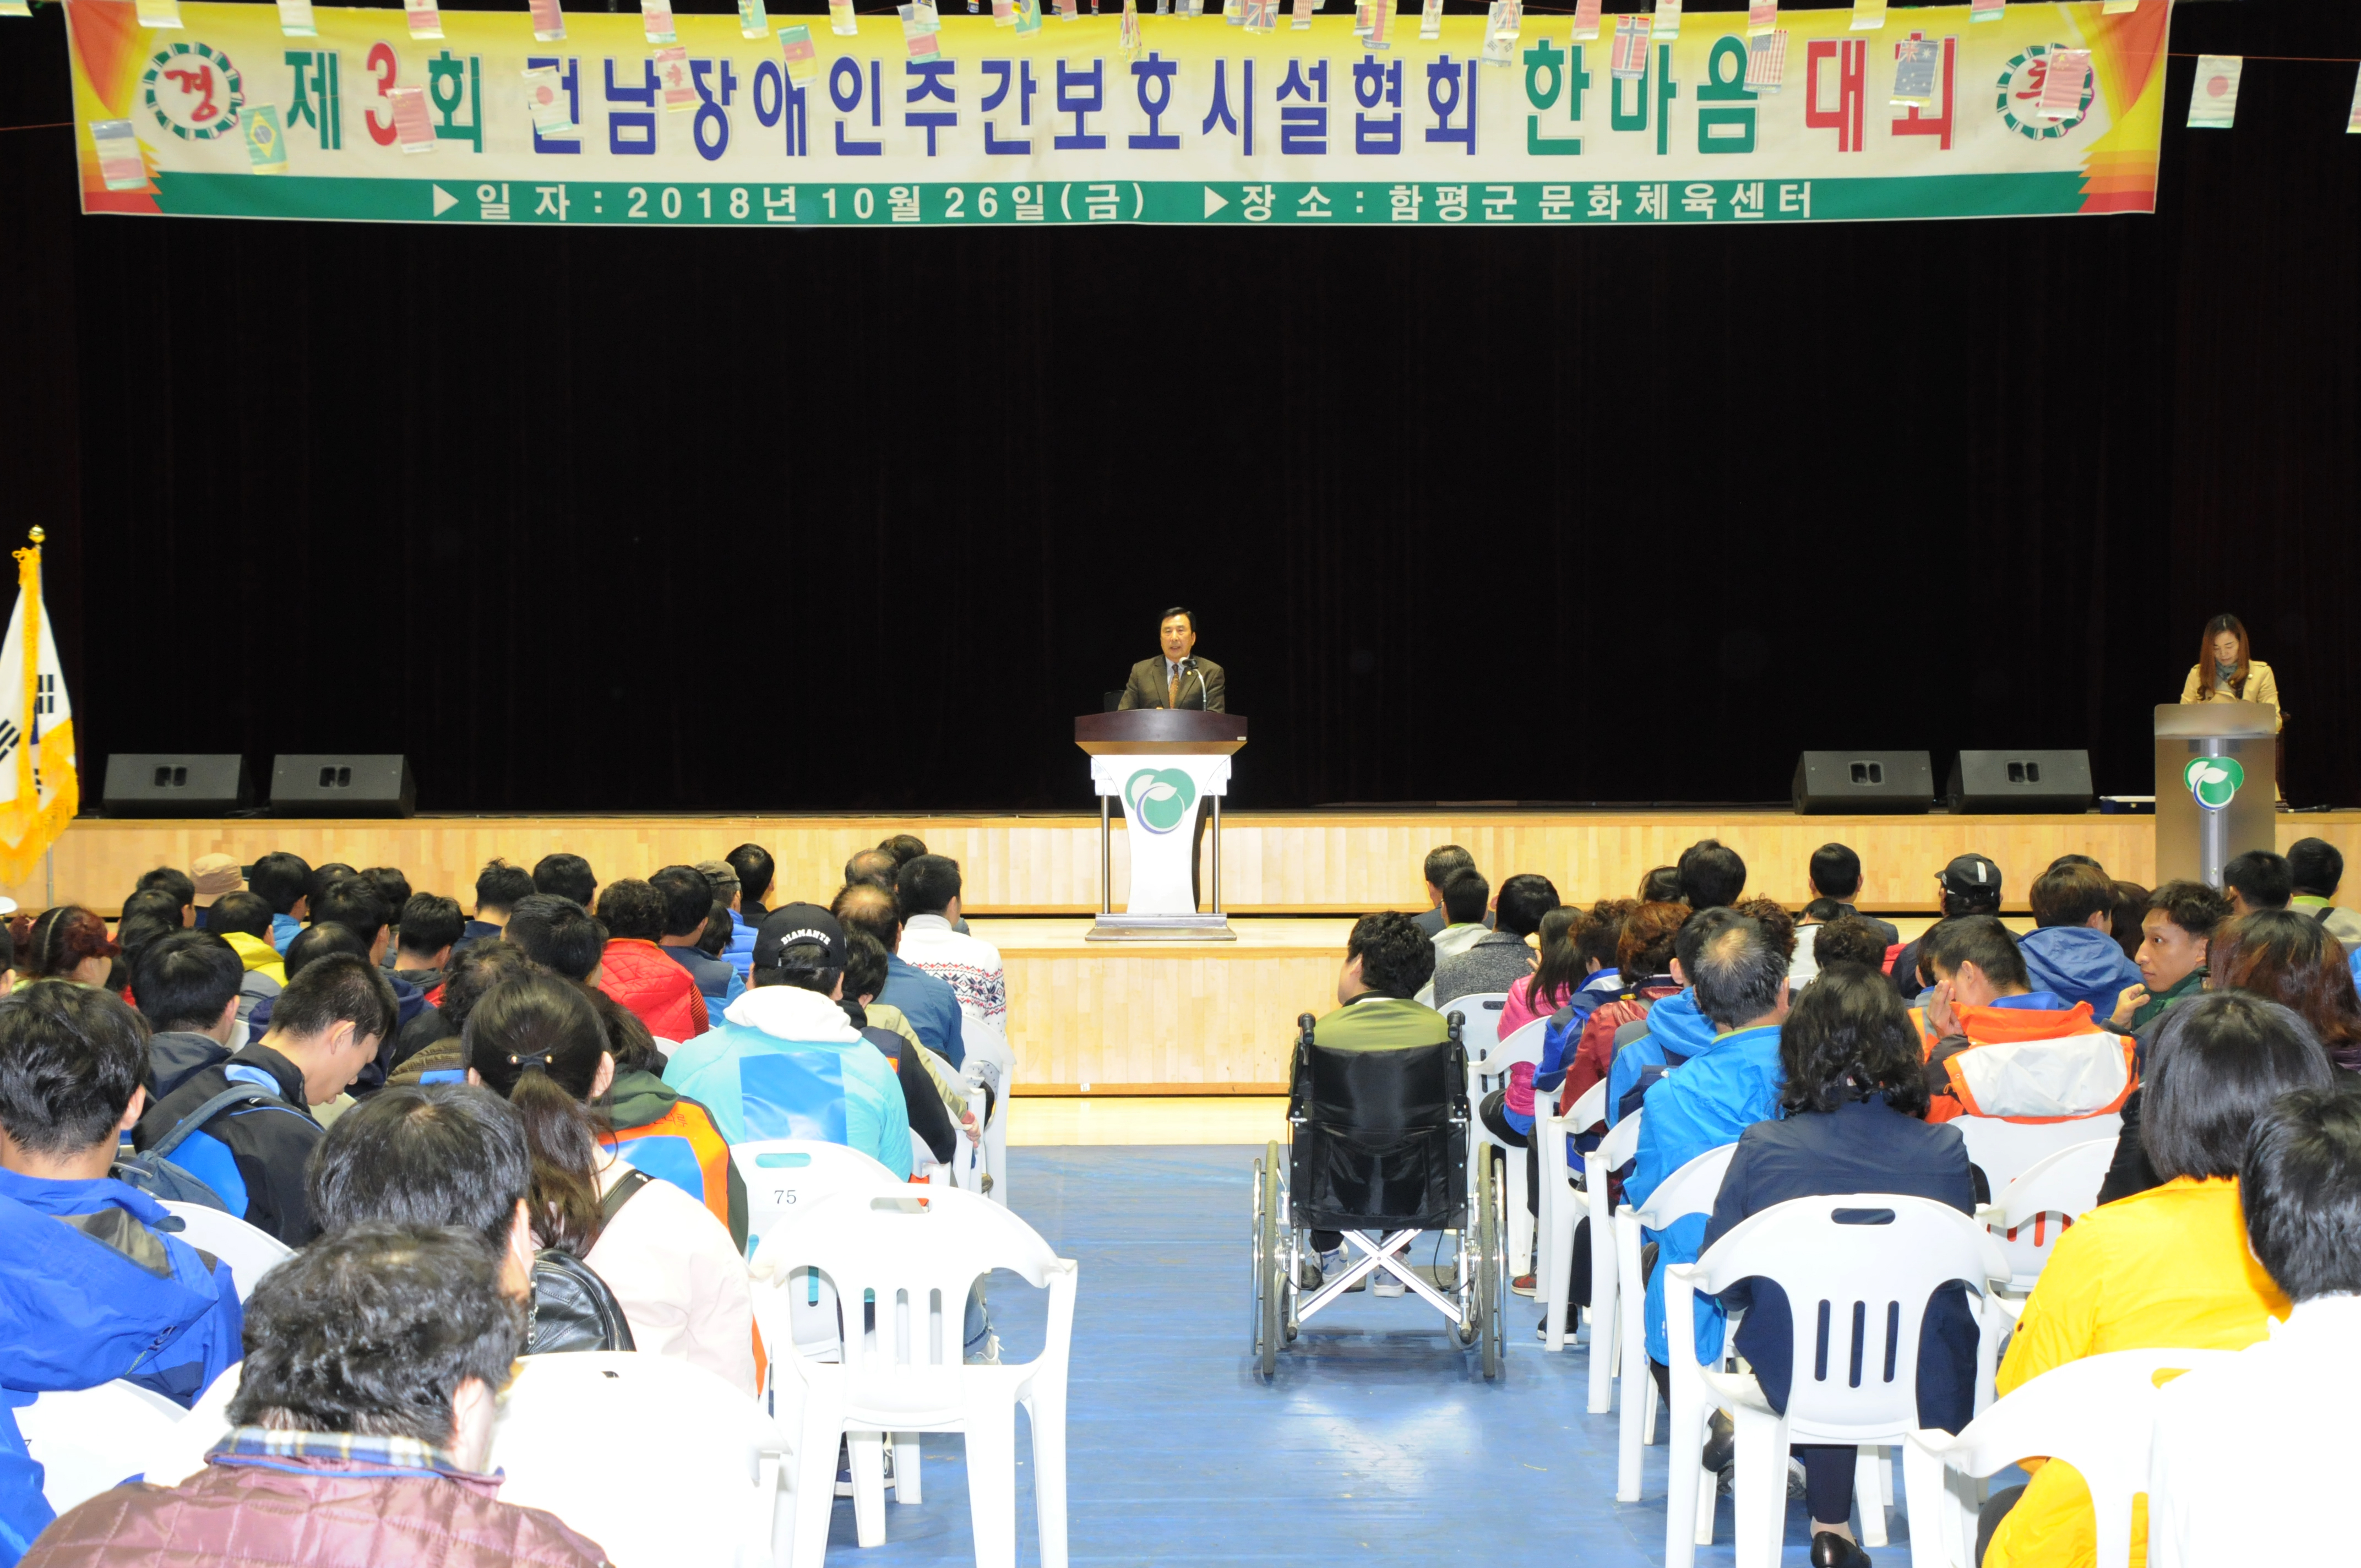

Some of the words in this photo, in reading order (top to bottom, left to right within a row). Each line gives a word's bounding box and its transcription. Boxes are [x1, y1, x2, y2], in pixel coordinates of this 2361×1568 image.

[285, 42, 482, 153] 제3회
[1523, 36, 1759, 155] 한마음
[627, 185, 797, 222] 2018년
[822, 185, 921, 222] 10월
[1389, 184, 1518, 222] 함평군
[1538, 182, 1812, 222] 문화체육센터
[780, 928, 831, 945] DIAMANTE
[774, 1189, 797, 1204] 75
